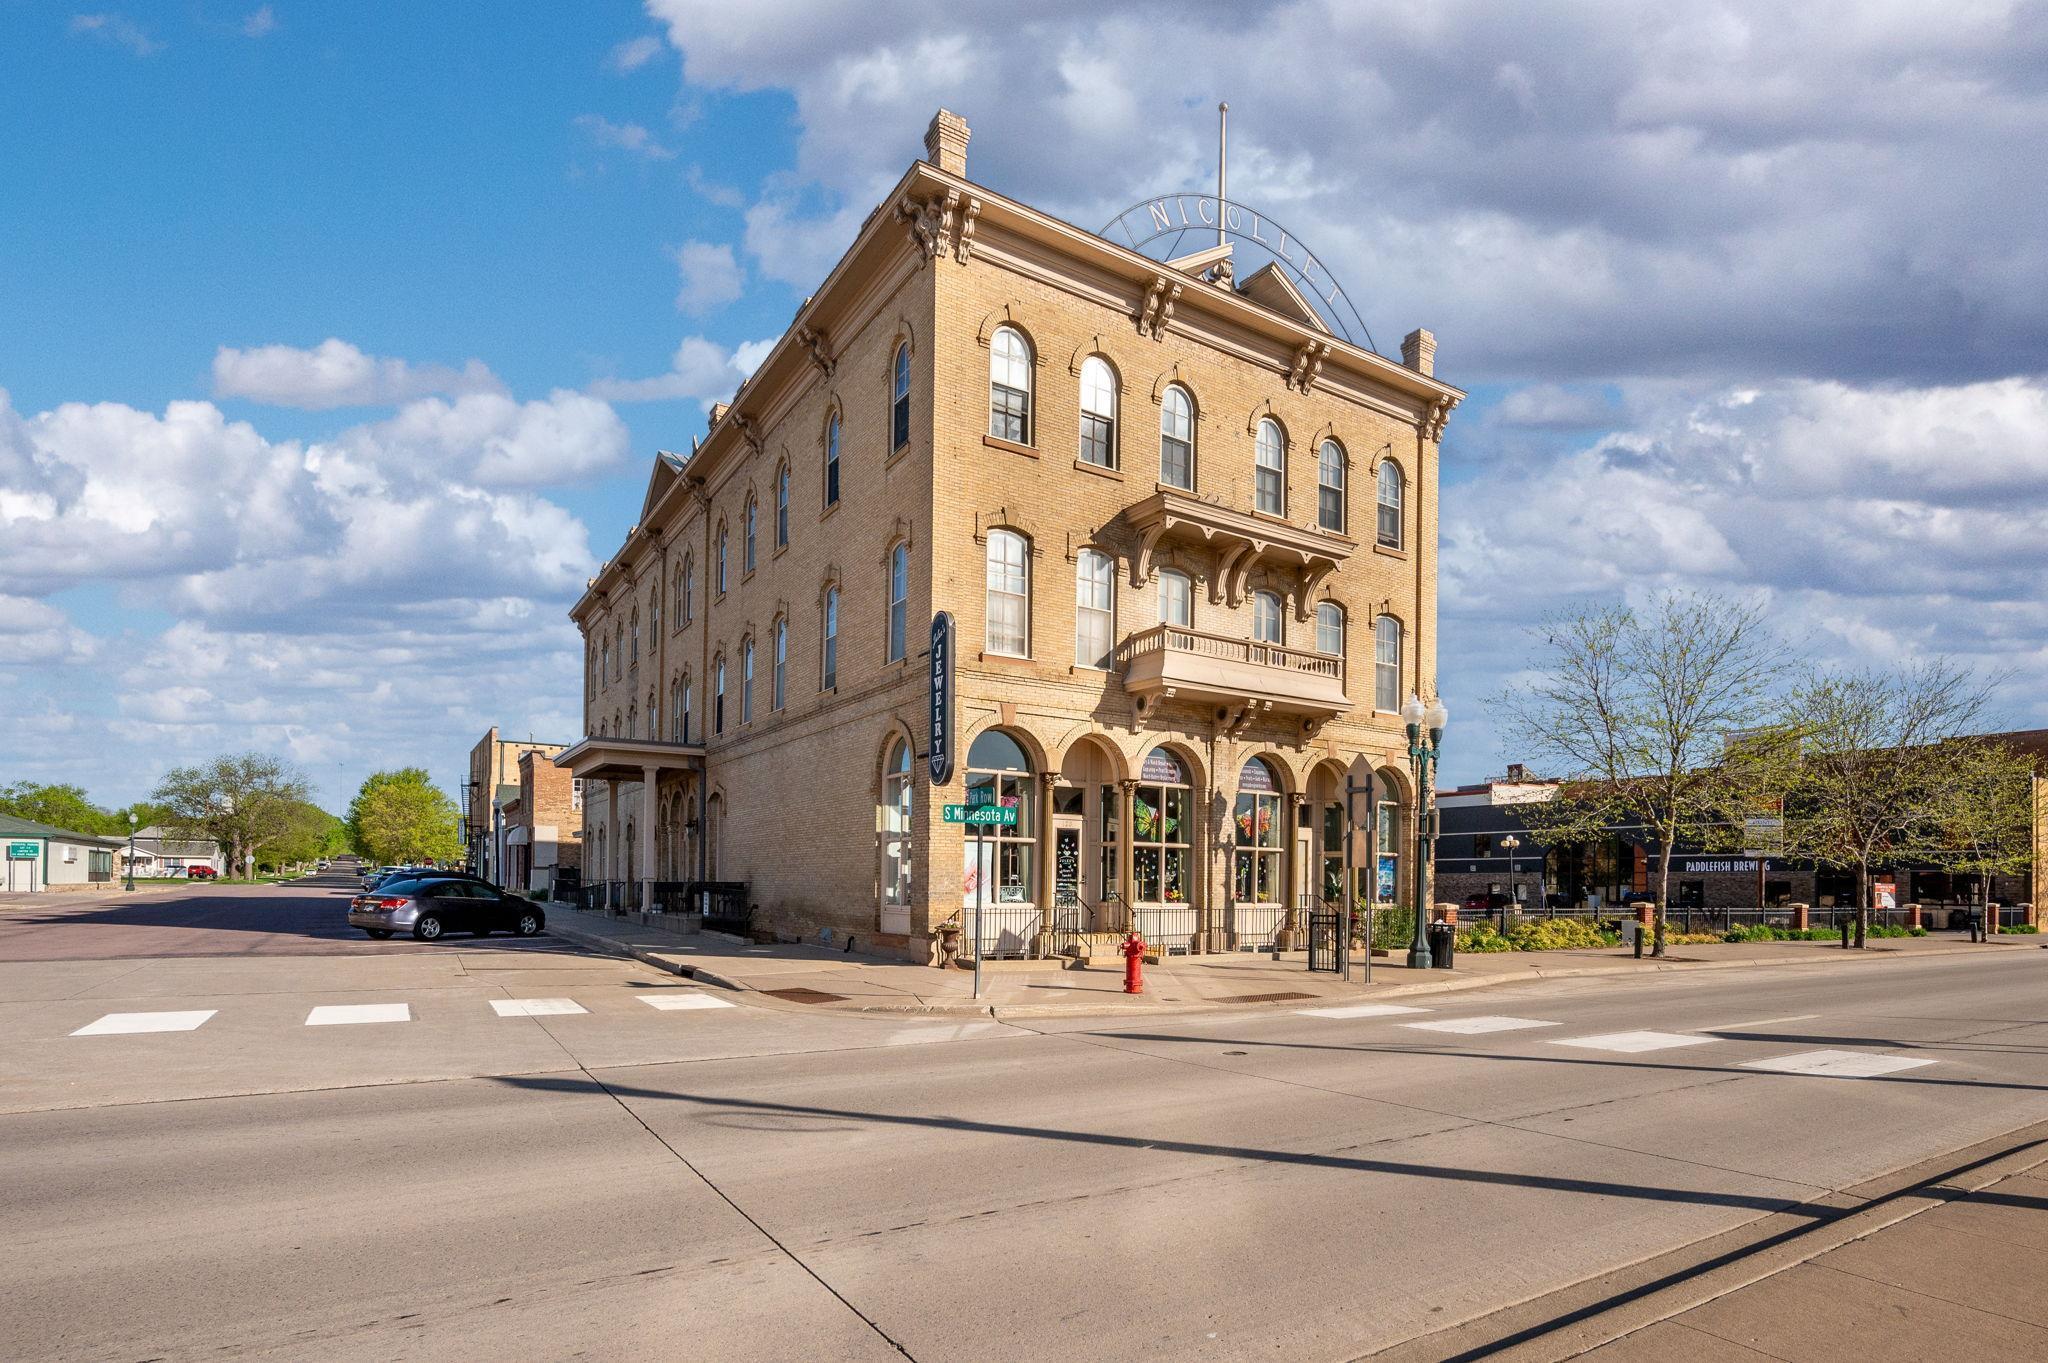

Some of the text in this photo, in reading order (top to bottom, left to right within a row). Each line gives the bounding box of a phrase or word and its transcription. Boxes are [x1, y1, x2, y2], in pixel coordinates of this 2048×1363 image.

[1148, 198, 1343, 305] NICOLLET
[933, 644, 944, 754] JEWELRY
[980, 790, 992, 804] Row
[944, 806, 1015, 822] S Minnesota Av
[1686, 860, 1770, 872] PADDLEFISH BREWIG
